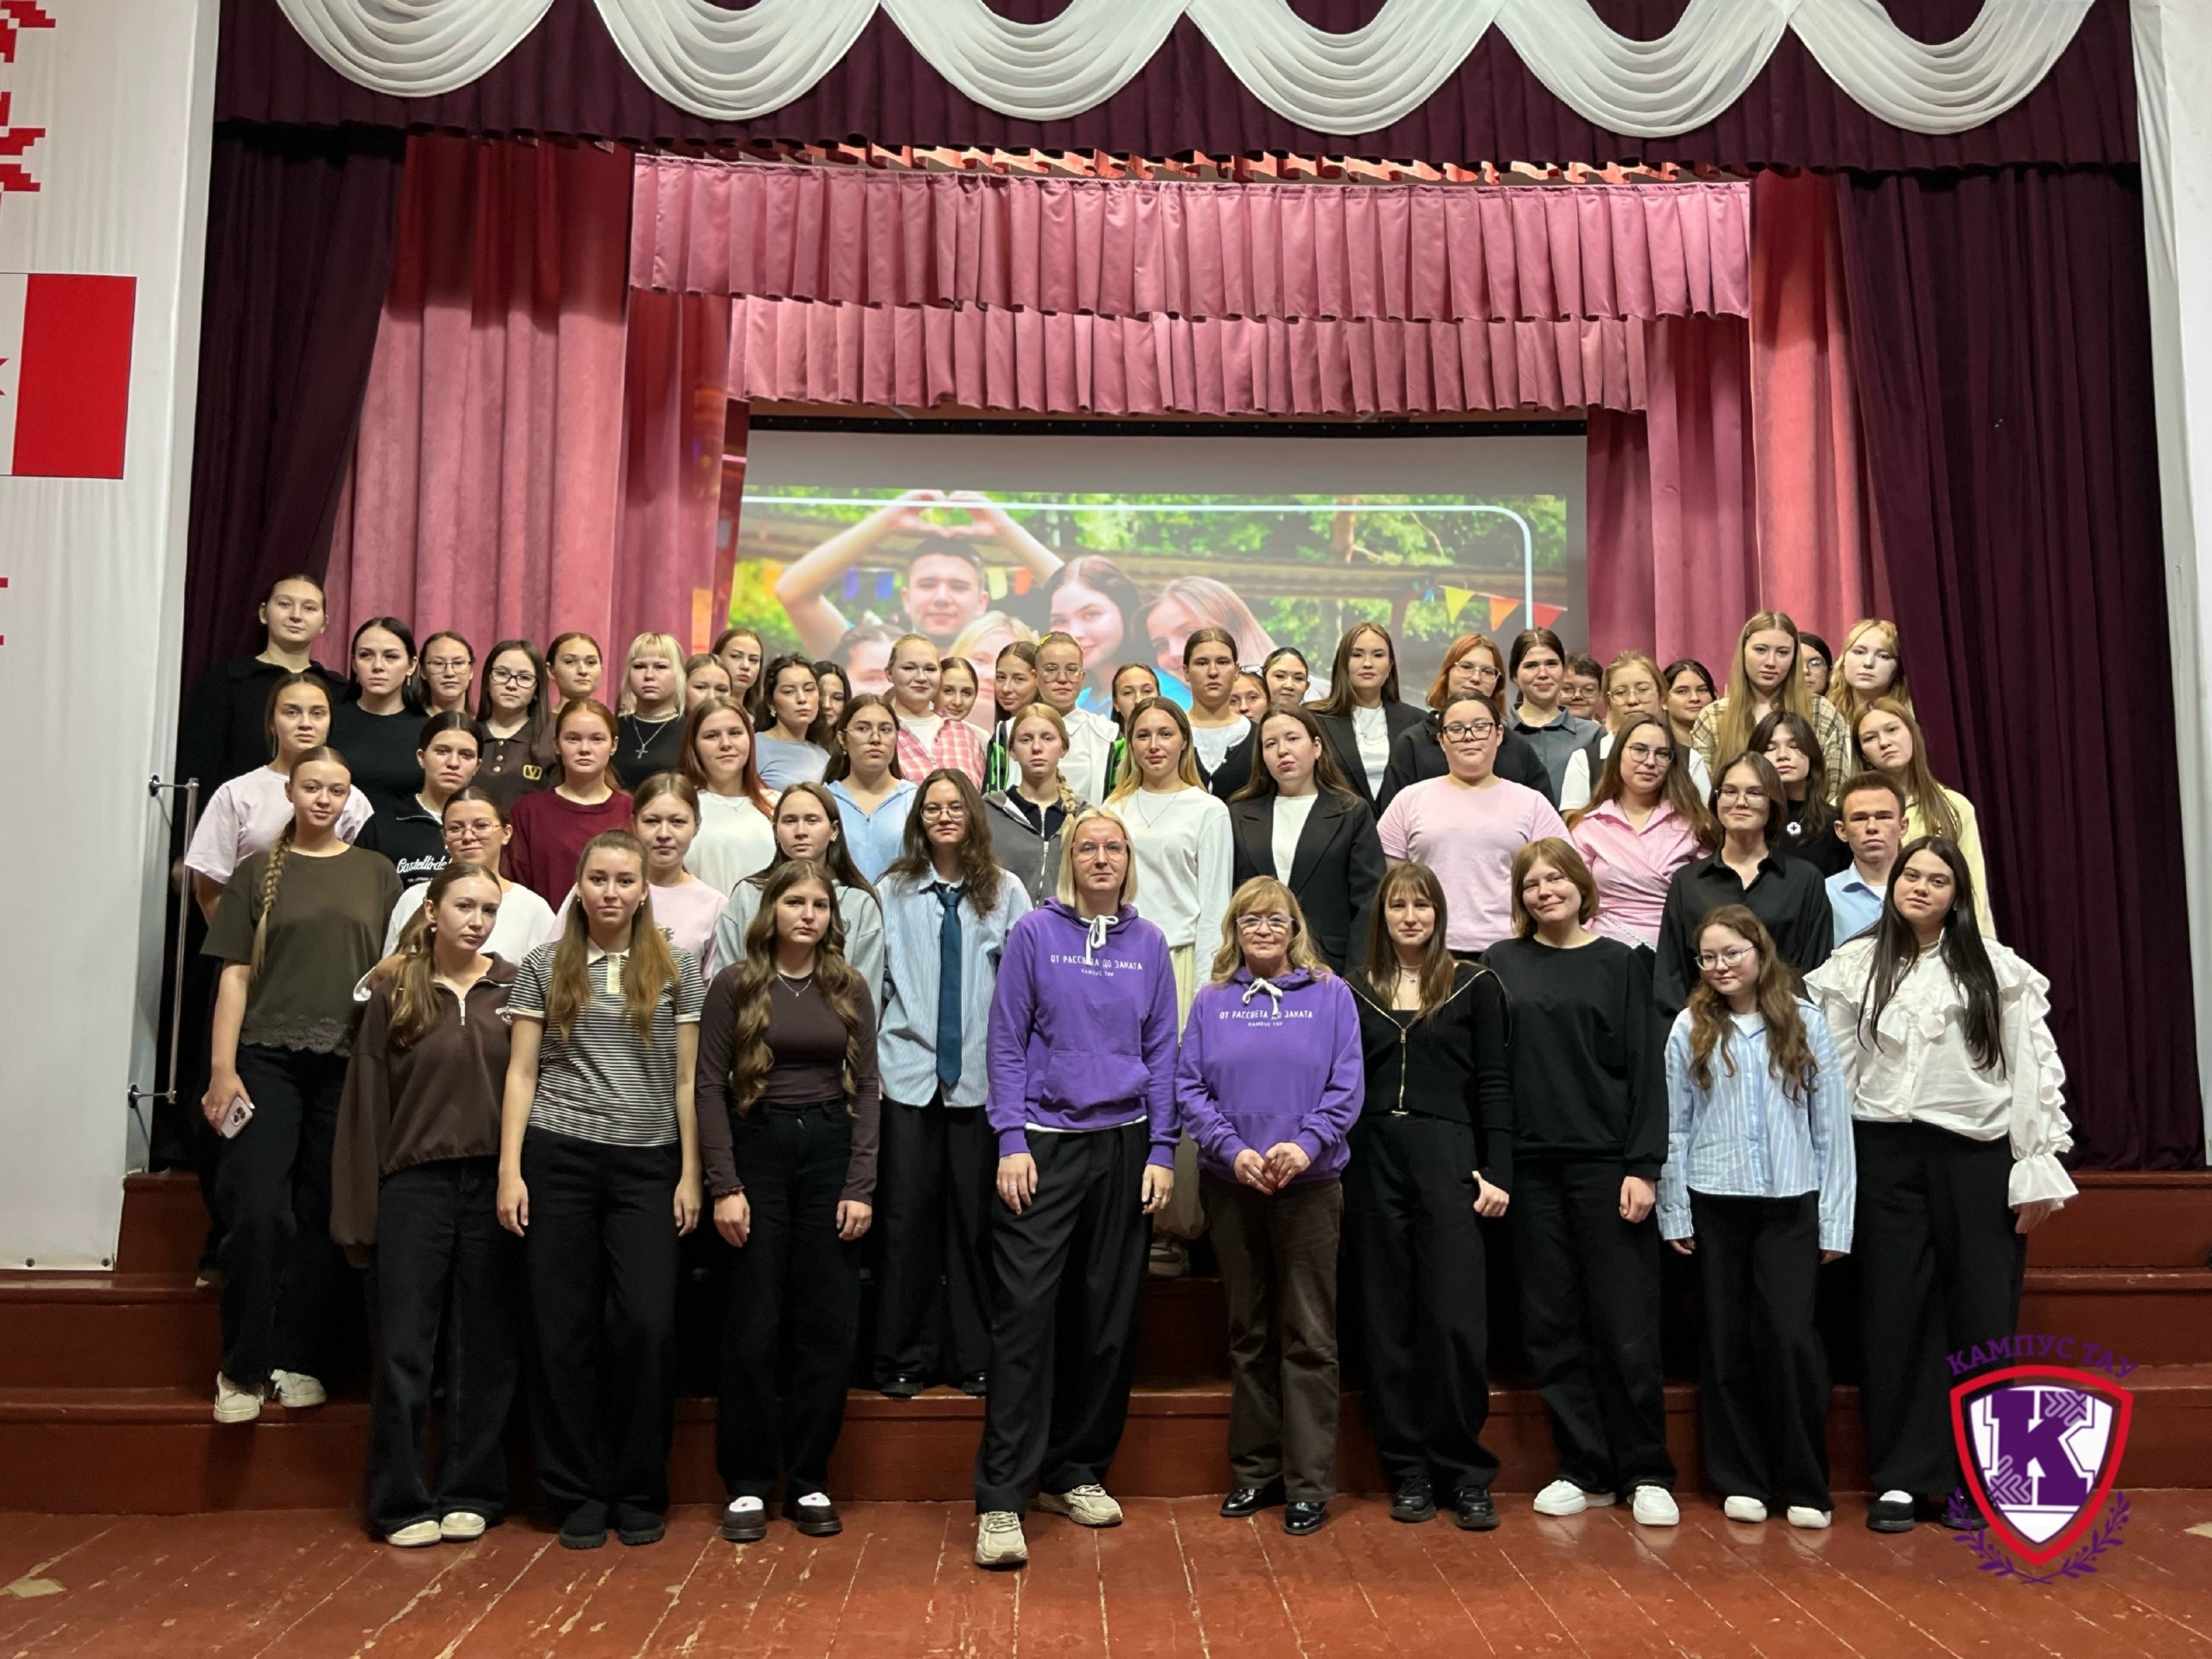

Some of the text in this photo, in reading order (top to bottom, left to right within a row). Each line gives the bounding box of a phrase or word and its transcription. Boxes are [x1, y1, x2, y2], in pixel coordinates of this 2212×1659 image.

[1051, 954, 1143, 970] ОТ РАССВТА ДО ЗАКАТА
[1219, 1011, 1230, 1019] ОТ
[1232, 1010, 1269, 1019] РАССВЕТА
[1284, 1010, 1314, 1018] ЗАКАТА
